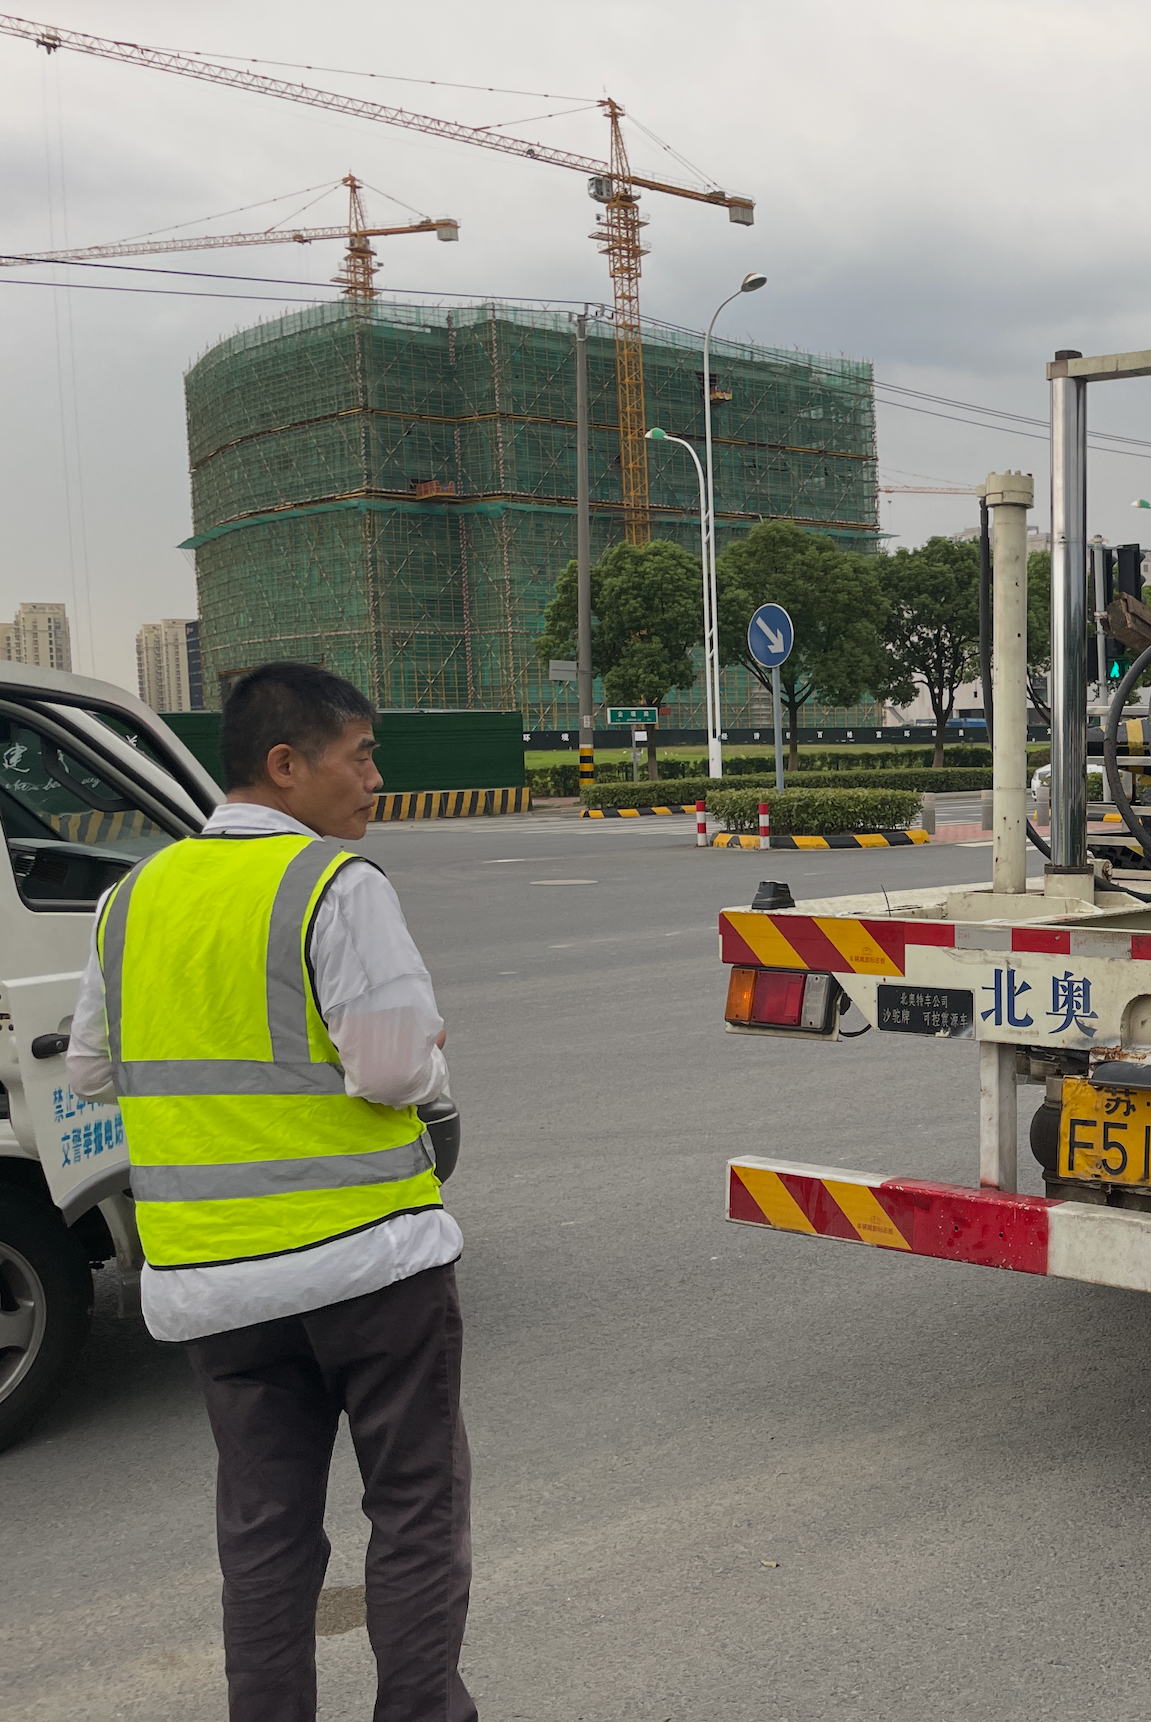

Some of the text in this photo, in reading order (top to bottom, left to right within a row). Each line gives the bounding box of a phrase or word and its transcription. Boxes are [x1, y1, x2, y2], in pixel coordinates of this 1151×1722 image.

[900, 992, 948, 1009] 北奥特车公司
